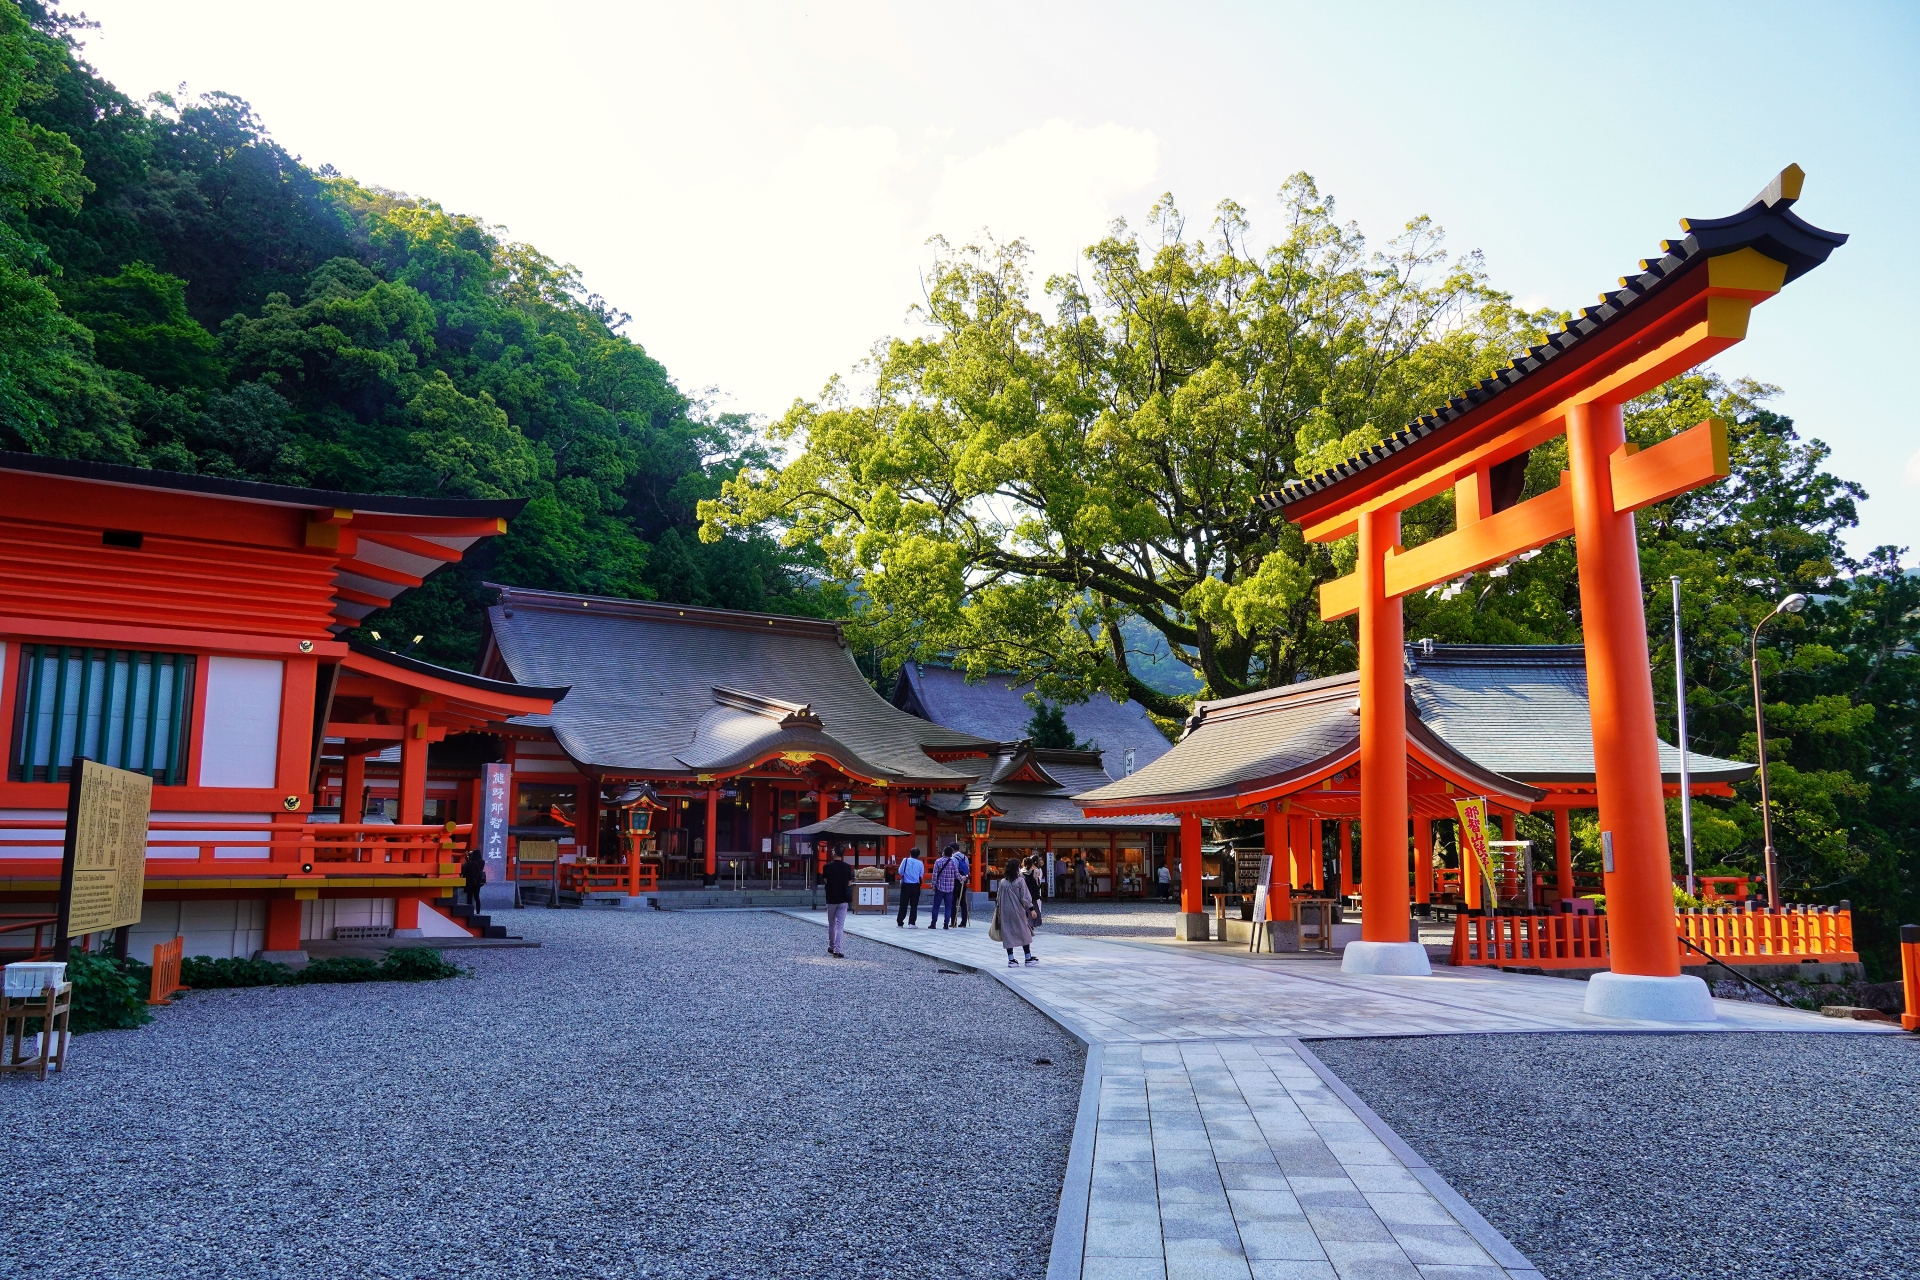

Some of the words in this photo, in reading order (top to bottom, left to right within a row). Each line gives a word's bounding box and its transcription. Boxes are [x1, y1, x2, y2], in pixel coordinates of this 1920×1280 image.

[488, 772, 505, 859] 熊野那智大社
